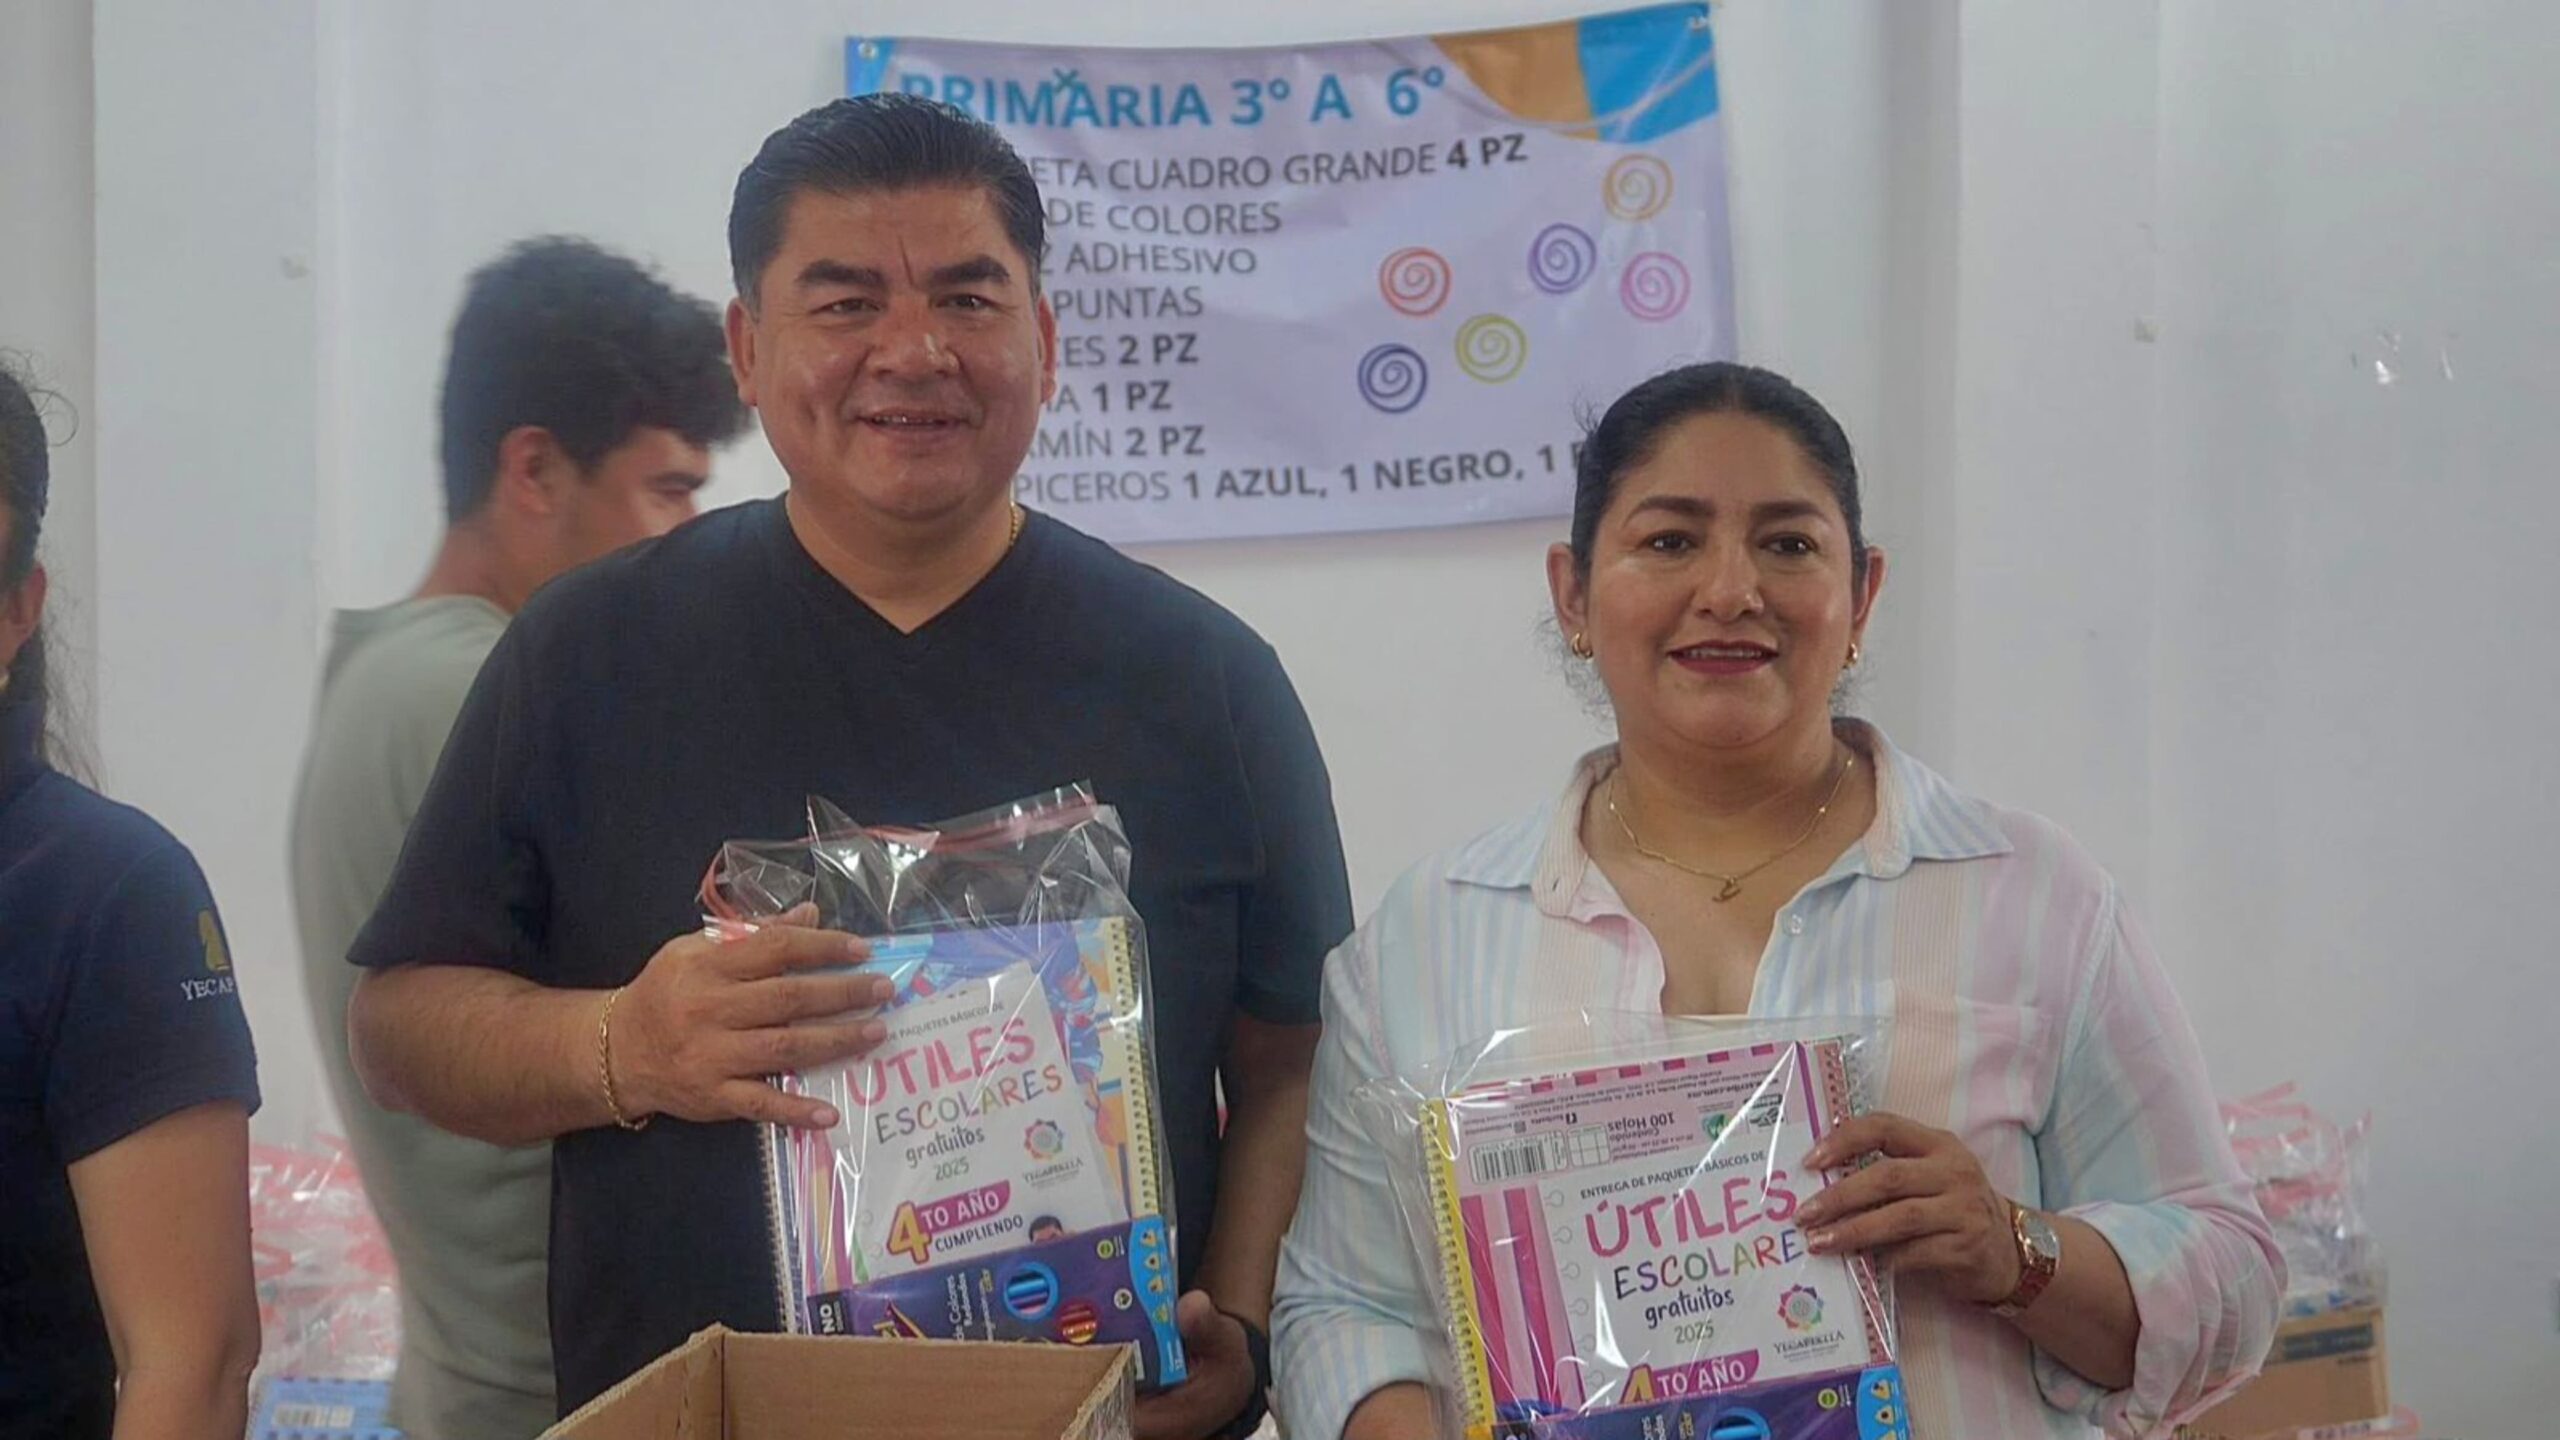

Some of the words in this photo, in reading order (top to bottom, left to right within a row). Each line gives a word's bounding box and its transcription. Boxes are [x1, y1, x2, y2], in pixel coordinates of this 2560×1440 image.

[901, 73, 1211, 128] PRIMARIA
[1310, 73, 1353, 122] A
[1030, 156, 1098, 188] ETA
[1108, 155, 1271, 191] CUADRO
[1283, 143, 1436, 185] GRANDE
[1446, 140, 1468, 170] 4
[1481, 133, 1527, 165] PZ
[1046, 198, 1095, 229] DE
[1107, 202, 1282, 236] COLORES
[1065, 241, 1257, 275] ADHESIVO
[1054, 286, 1204, 320] PUNTAS
[1061, 335, 1106, 368] ES
[1119, 334, 1140, 366] 2
[1153, 332, 1199, 365] PZ
[1092, 382, 1109, 412] 1
[1126, 380, 1172, 411] PZ
[1033, 421, 1112, 457] MÍN
[1125, 426, 1147, 457] 2
[1160, 425, 1205, 456] PZ
[1014, 471, 1171, 501] PICEROS
[1184, 472, 1200, 499] 1
[1340, 464, 1358, 492] 1
[1537, 444, 1556, 473] 1
[848, 1017, 1036, 1107] ÚTILES
[875, 1064, 1063, 1145] ESCOLARES
[1650, 1111, 1675, 1126] 100
[1607, 1116, 1647, 1132] Hojas
[906, 1126, 986, 1170] gratuitos
[934, 1156, 971, 1181] 2025
[1580, 1179, 1630, 1199] ENTREGA
[1631, 1175, 1646, 1189] DE
[1751, 1150, 1766, 1163] DE
[957, 1190, 1000, 1221] AÑO
[1584, 1169, 1798, 1258] ÚTILES
[934, 1214, 1024, 1252] CUMPLIENDO
[1613, 1228, 1804, 1300] ESCOLARE
[1645, 1284, 1735, 1330] gratuitos
[1674, 1319, 1715, 1345] 2025
[1698, 1355, 1746, 1390] AÑO
